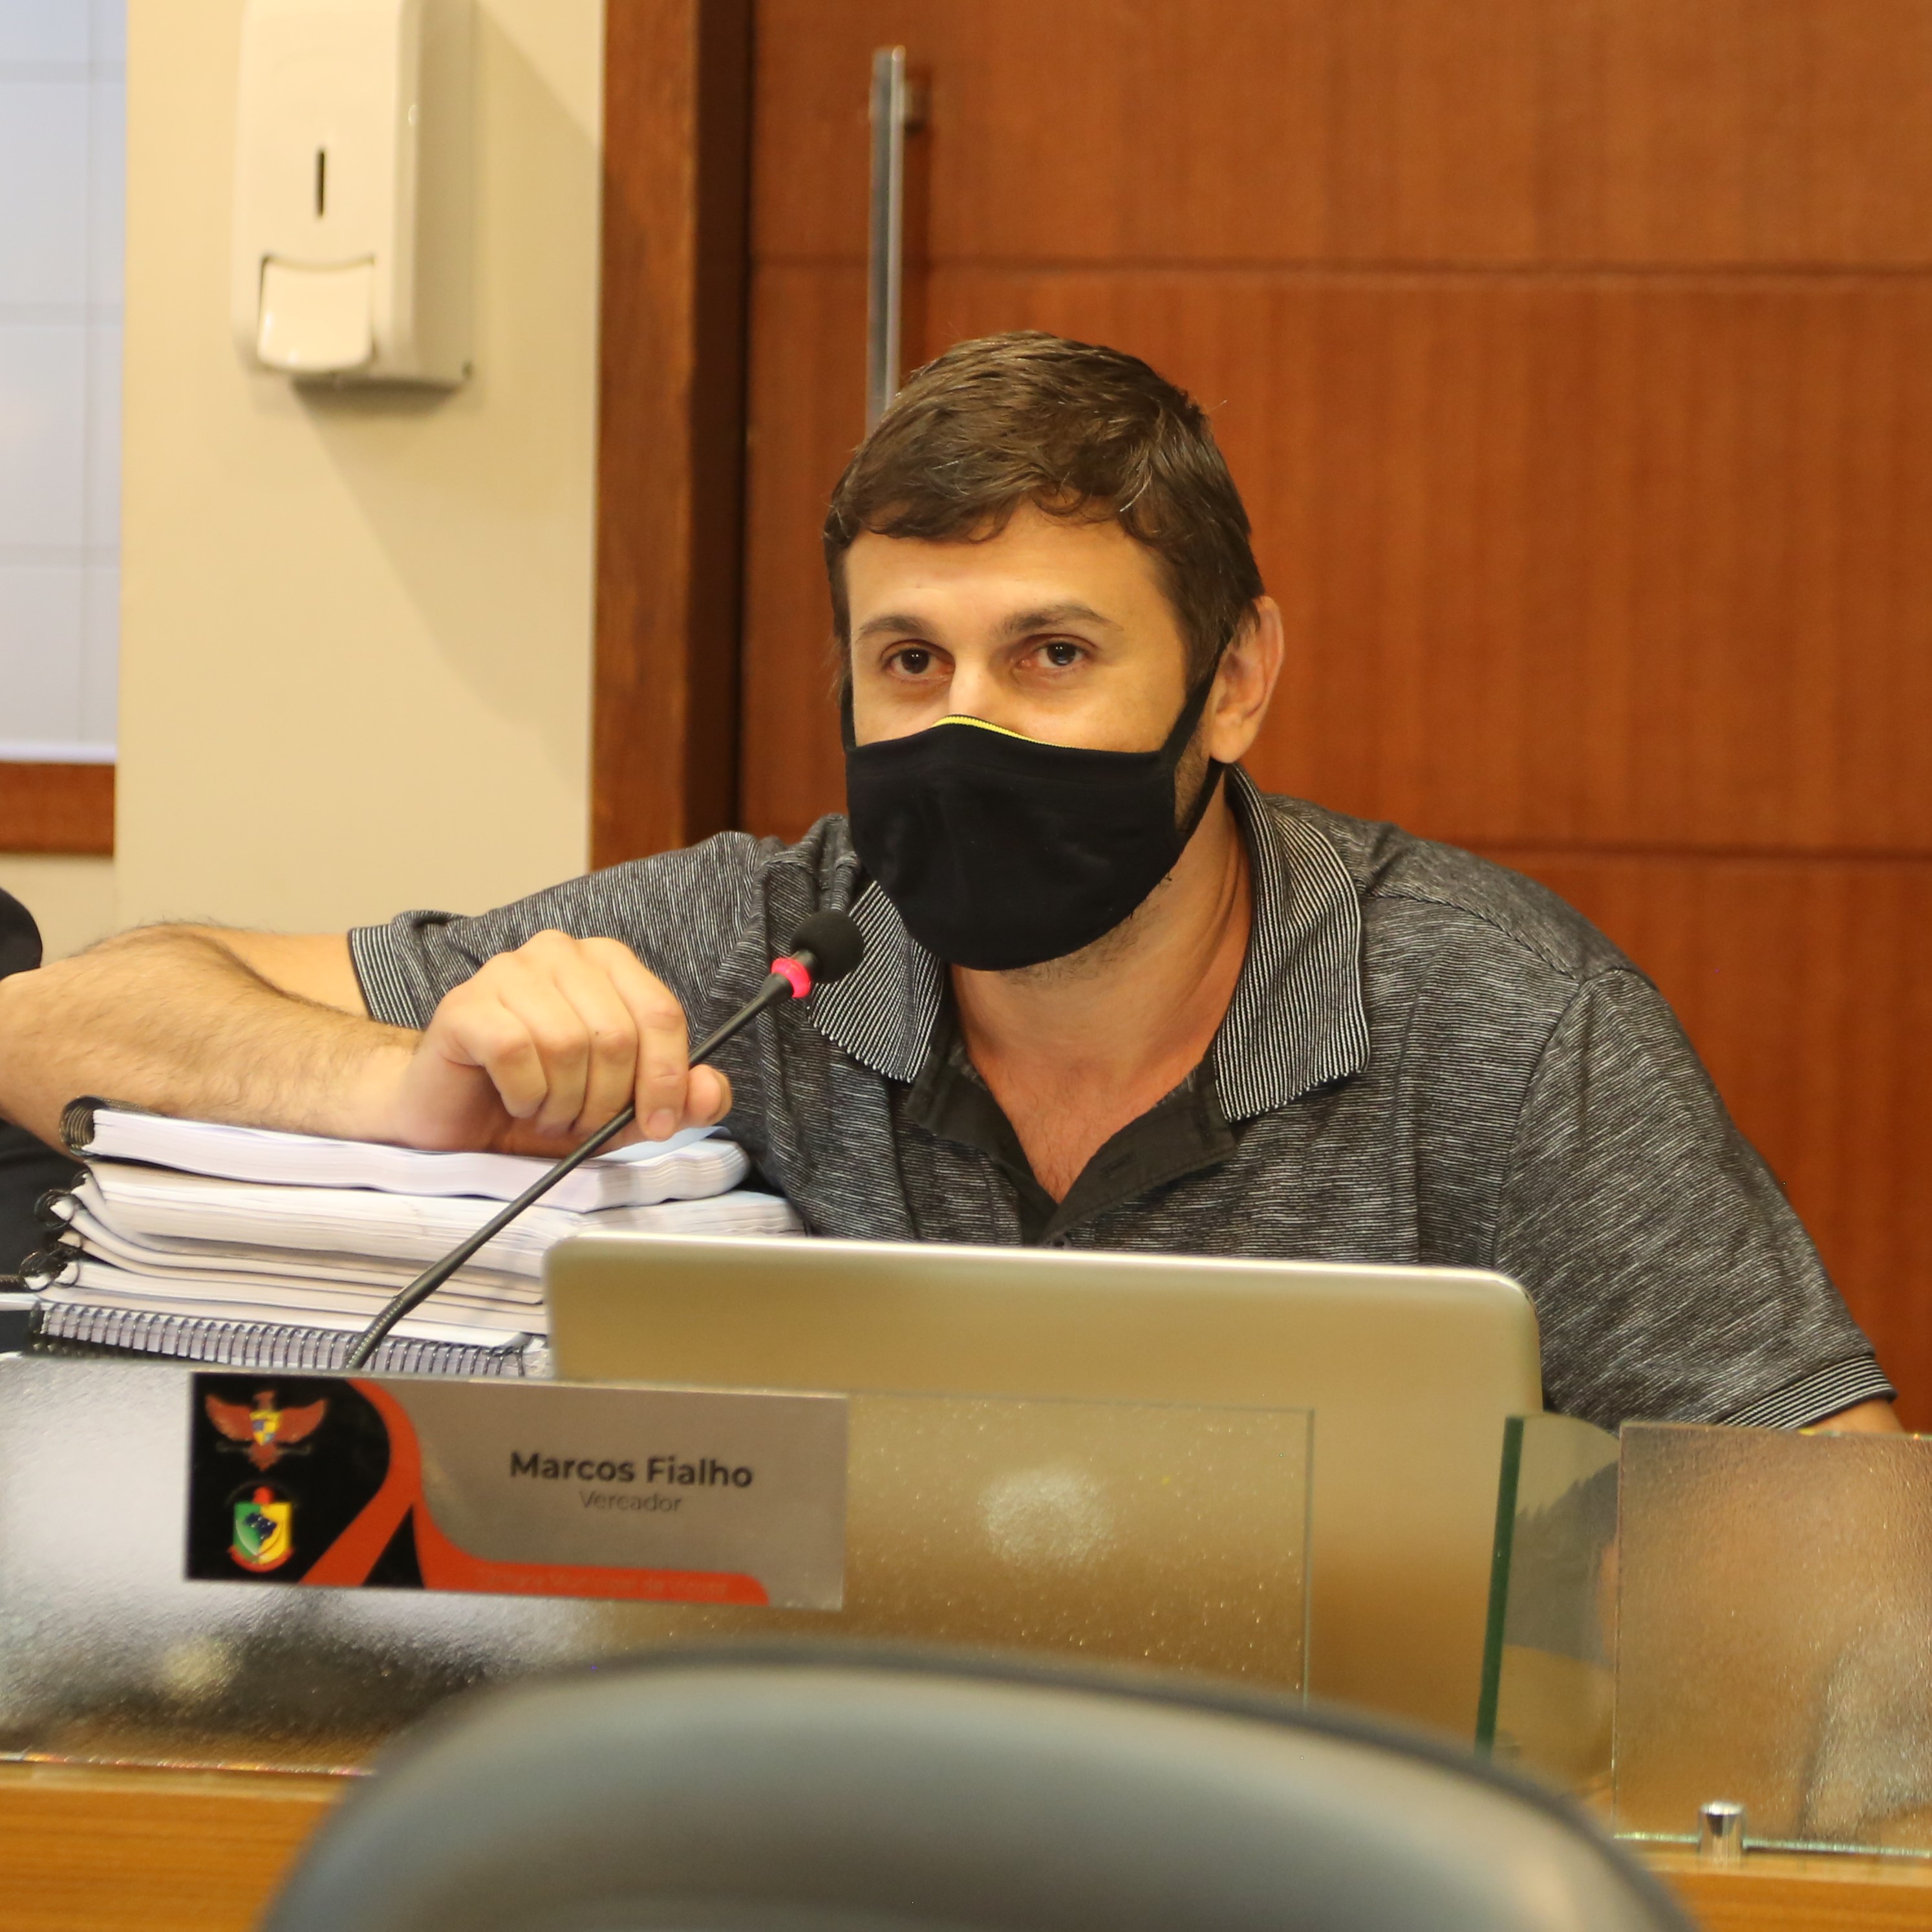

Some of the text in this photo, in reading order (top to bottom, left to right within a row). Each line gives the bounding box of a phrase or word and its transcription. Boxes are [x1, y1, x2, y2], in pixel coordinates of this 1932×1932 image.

[510, 1452, 753, 1488] Marcos Fialho
[579, 1490, 682, 1512] Vereador
